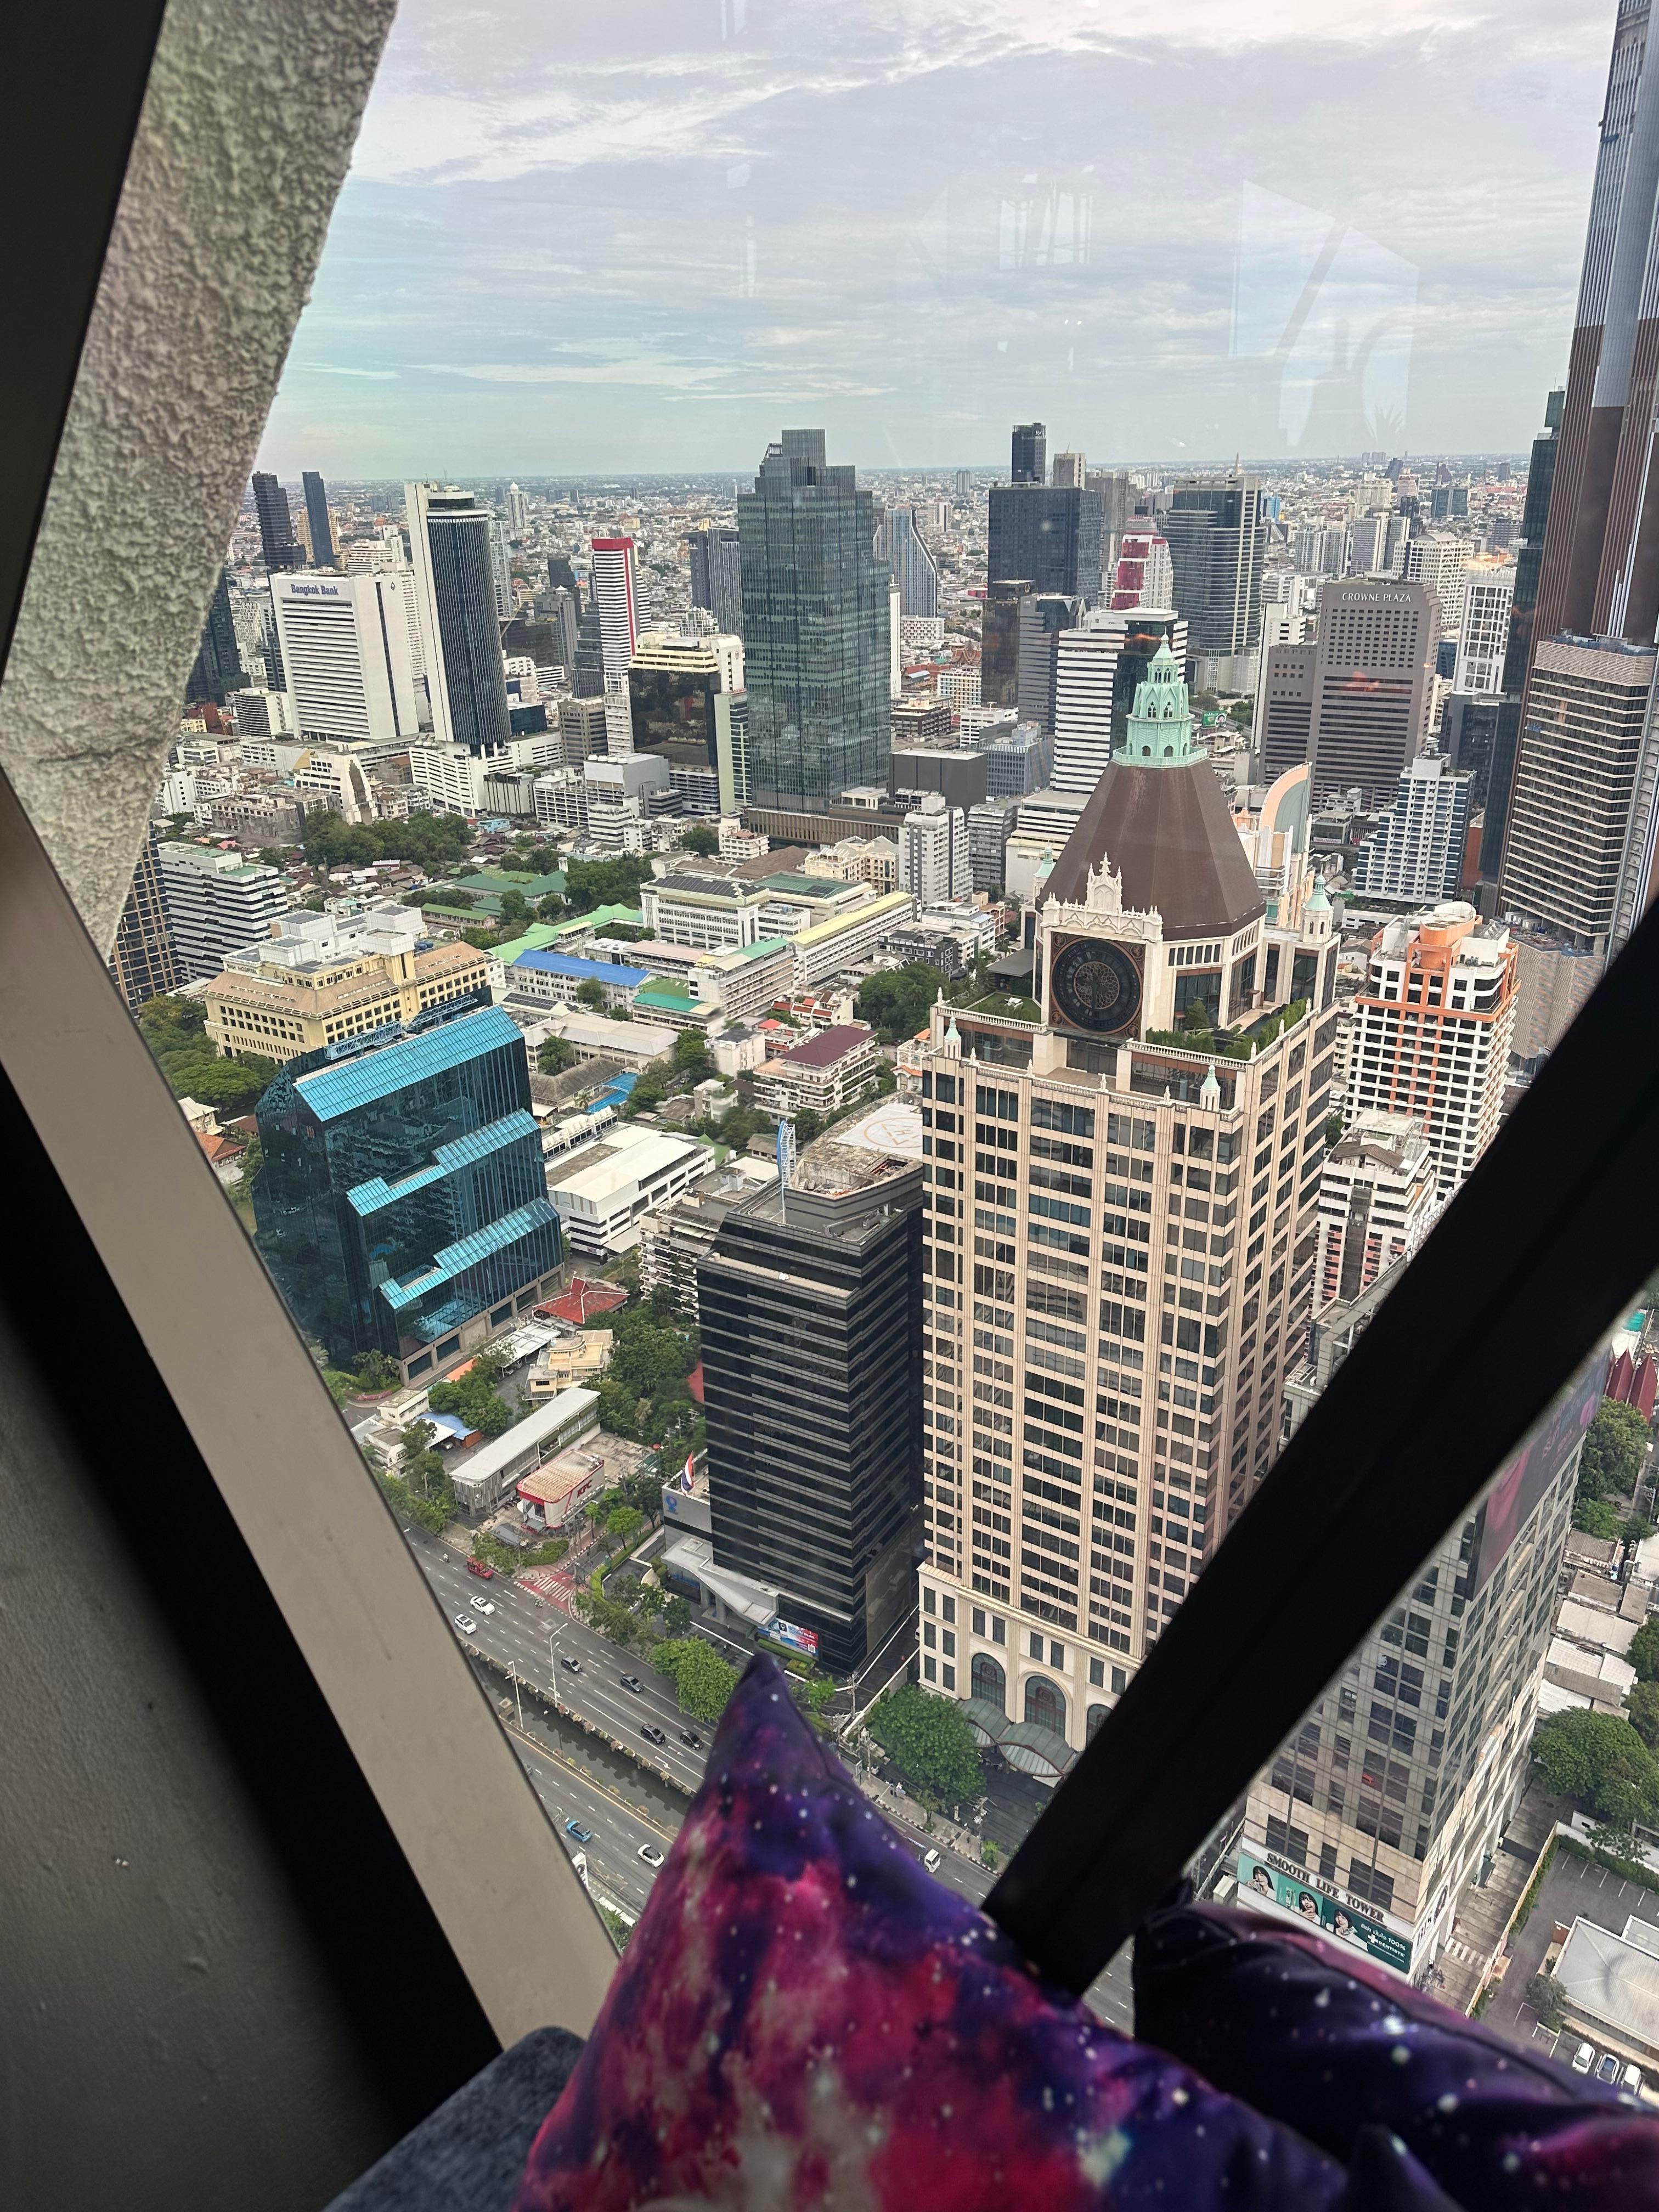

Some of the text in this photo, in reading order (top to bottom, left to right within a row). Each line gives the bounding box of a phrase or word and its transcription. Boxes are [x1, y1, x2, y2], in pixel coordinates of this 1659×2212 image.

[291, 584, 338, 596] Bangkok Bank
[1342, 592, 1411, 602] CROWNE PLAZA
[577, 1479, 593, 1498] KFC
[1267, 1853, 1311, 1883] SMOOTH
[1316, 1878, 1340, 1899] LIFE
[1346, 1893, 1384, 1923] TOWER
[1388, 1937, 1406, 1951] 100%
